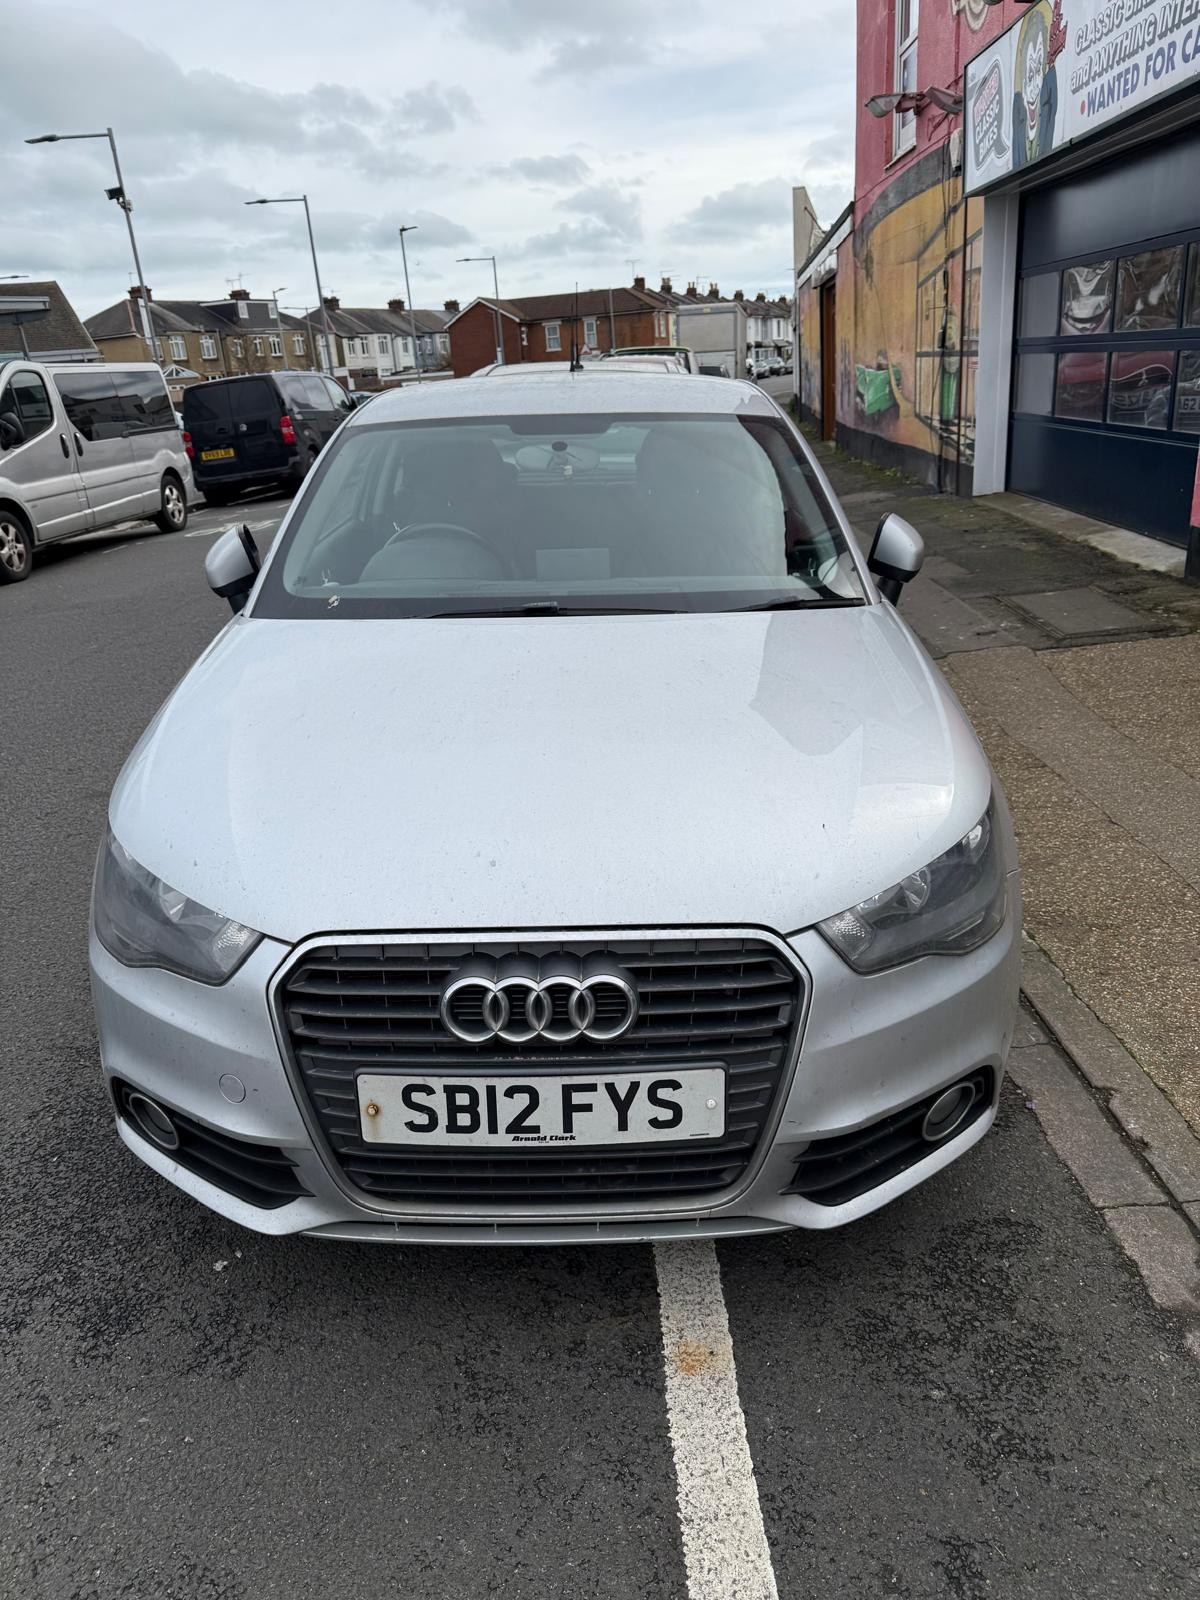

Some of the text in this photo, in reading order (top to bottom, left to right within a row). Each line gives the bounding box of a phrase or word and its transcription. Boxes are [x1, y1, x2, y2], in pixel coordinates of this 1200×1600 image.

[1070, 56, 1093, 95] and
[1091, 13, 1157, 82] ANYTHING
[1075, 0, 1124, 55] CLASSIC
[1087, 63, 1140, 117] WANTED
[1144, 41, 1177, 86] FOR
[401, 1079, 683, 1134] SB12 FYS
